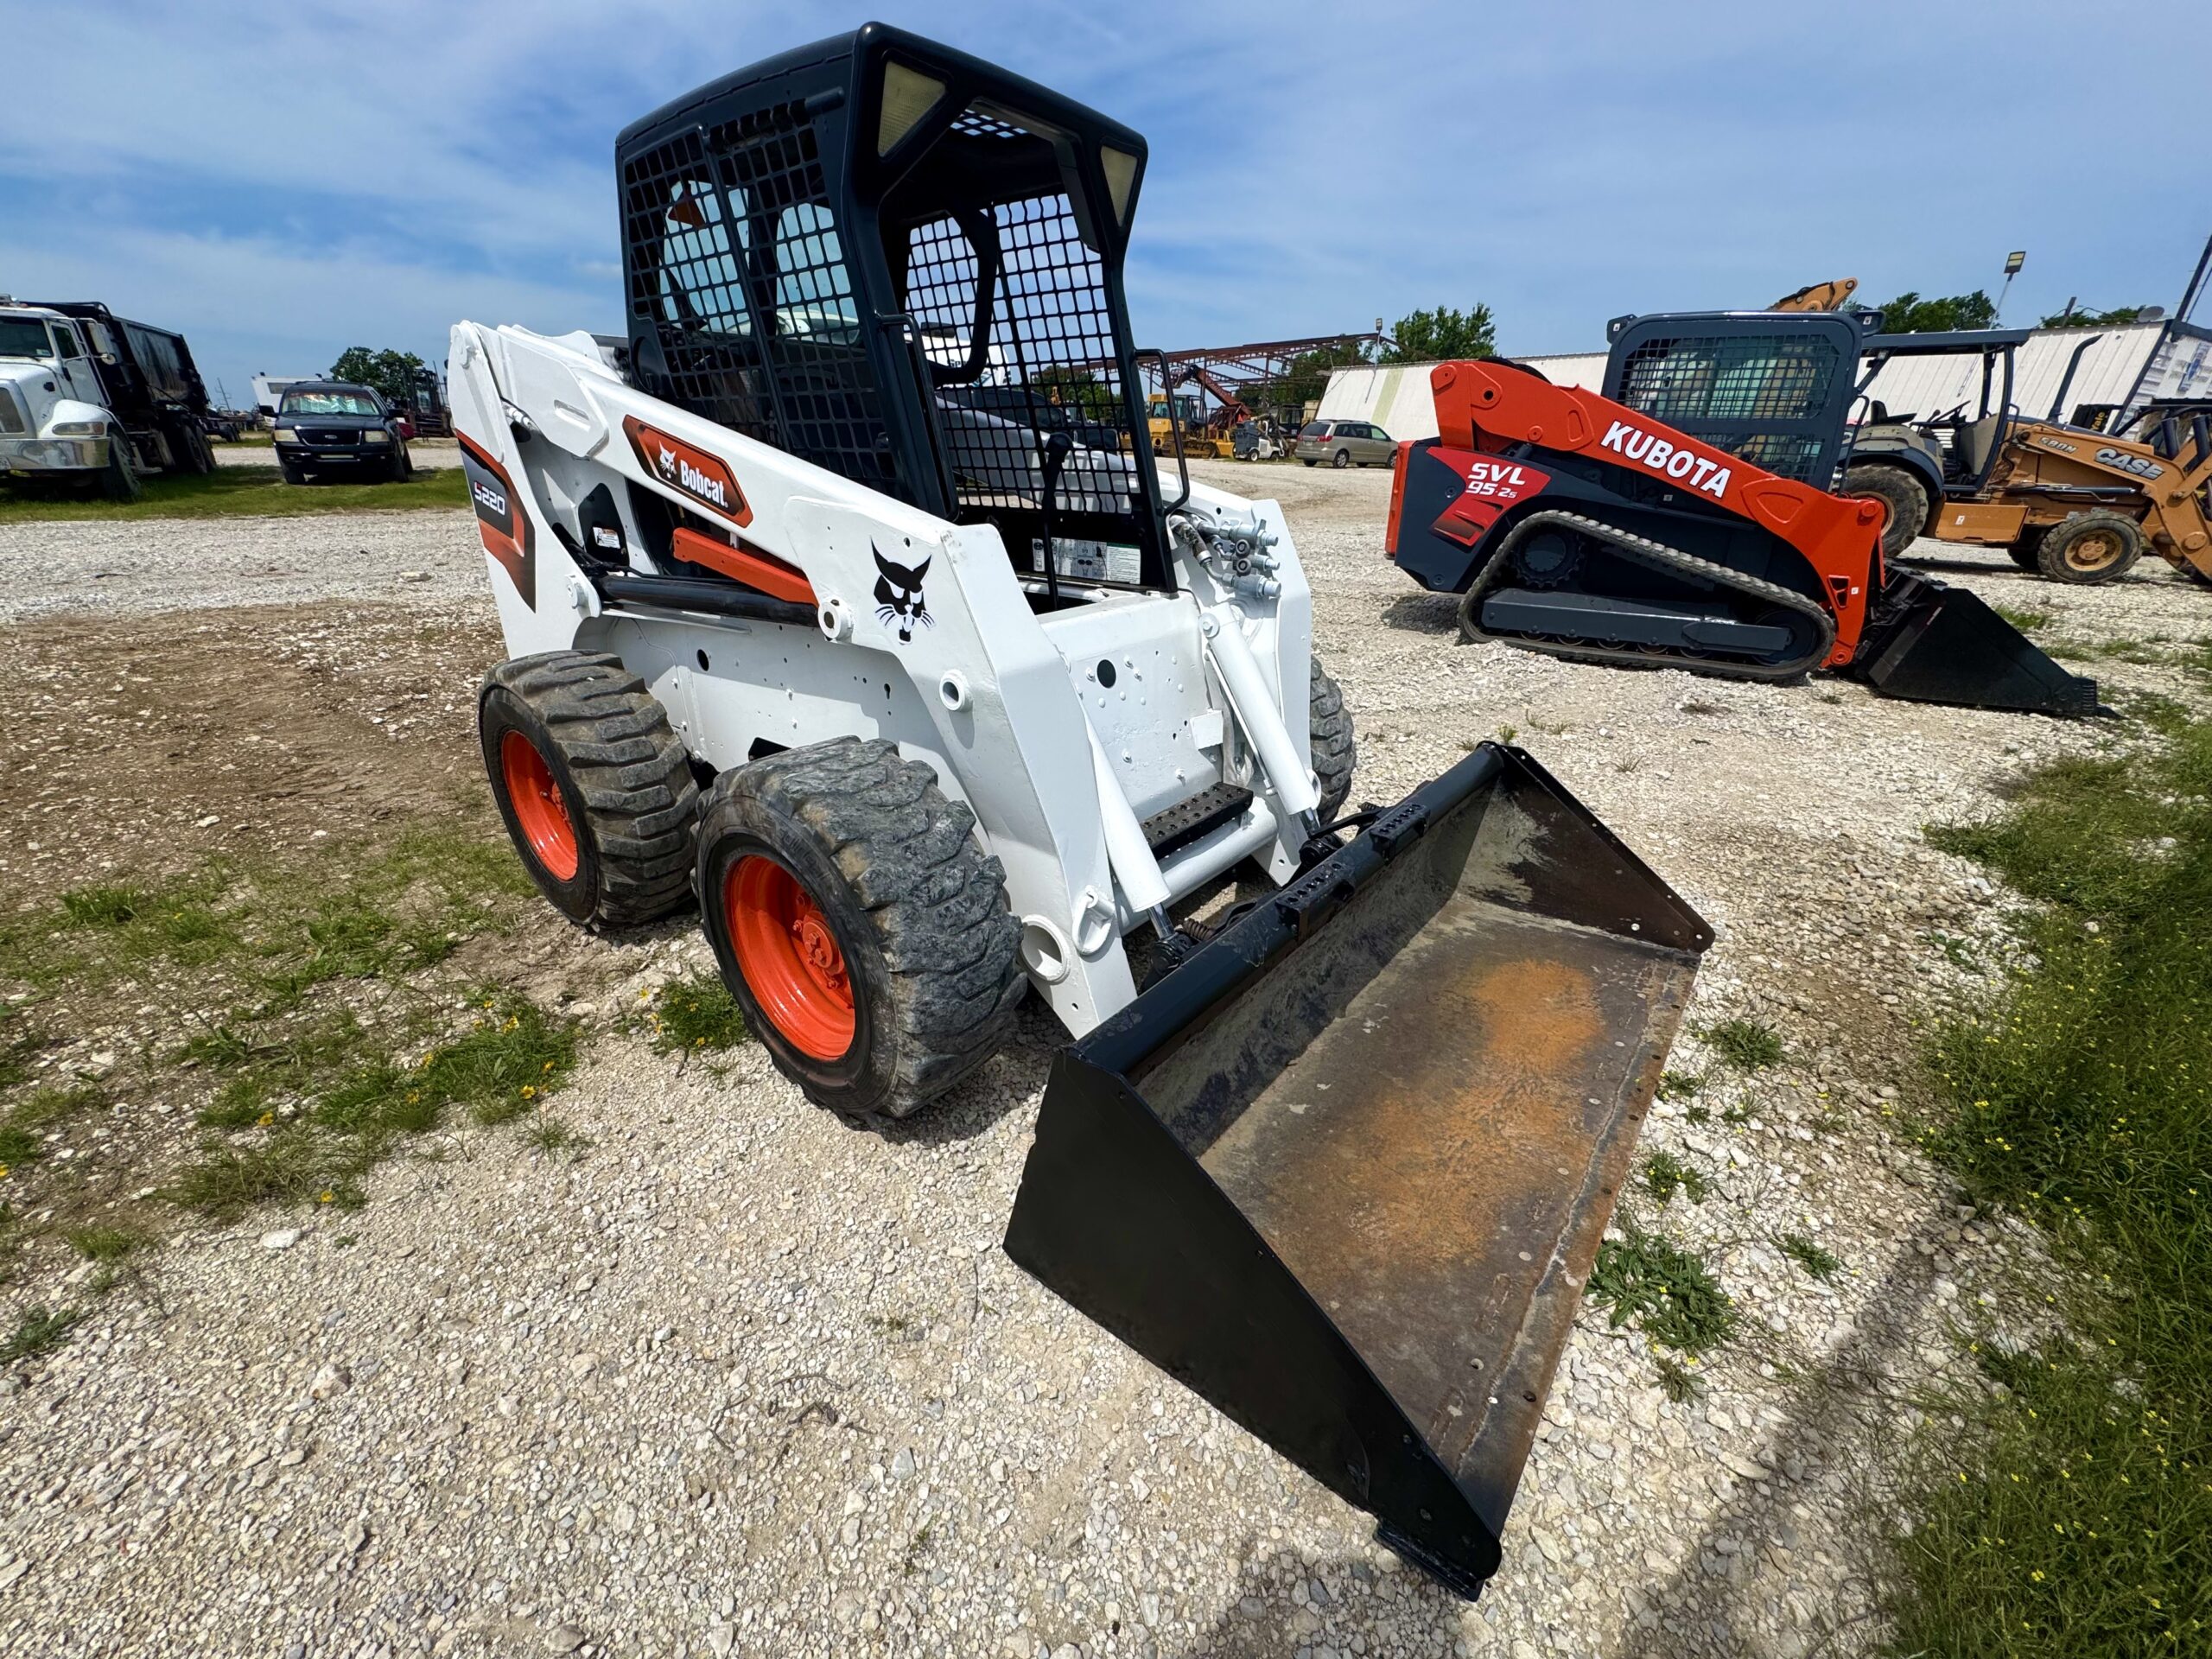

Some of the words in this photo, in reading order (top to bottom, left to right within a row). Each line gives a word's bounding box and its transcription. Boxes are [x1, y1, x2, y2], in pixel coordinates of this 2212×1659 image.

[2090, 411, 2105, 430] Yale
[1600, 420, 1732, 499] KUBOTA
[2038, 436, 2077, 454] 580N
[1467, 462, 1526, 486] SVL
[2094, 448, 2164, 480] CASE
[474, 480, 505, 516] S220
[680, 459, 726, 507] Bobcat
